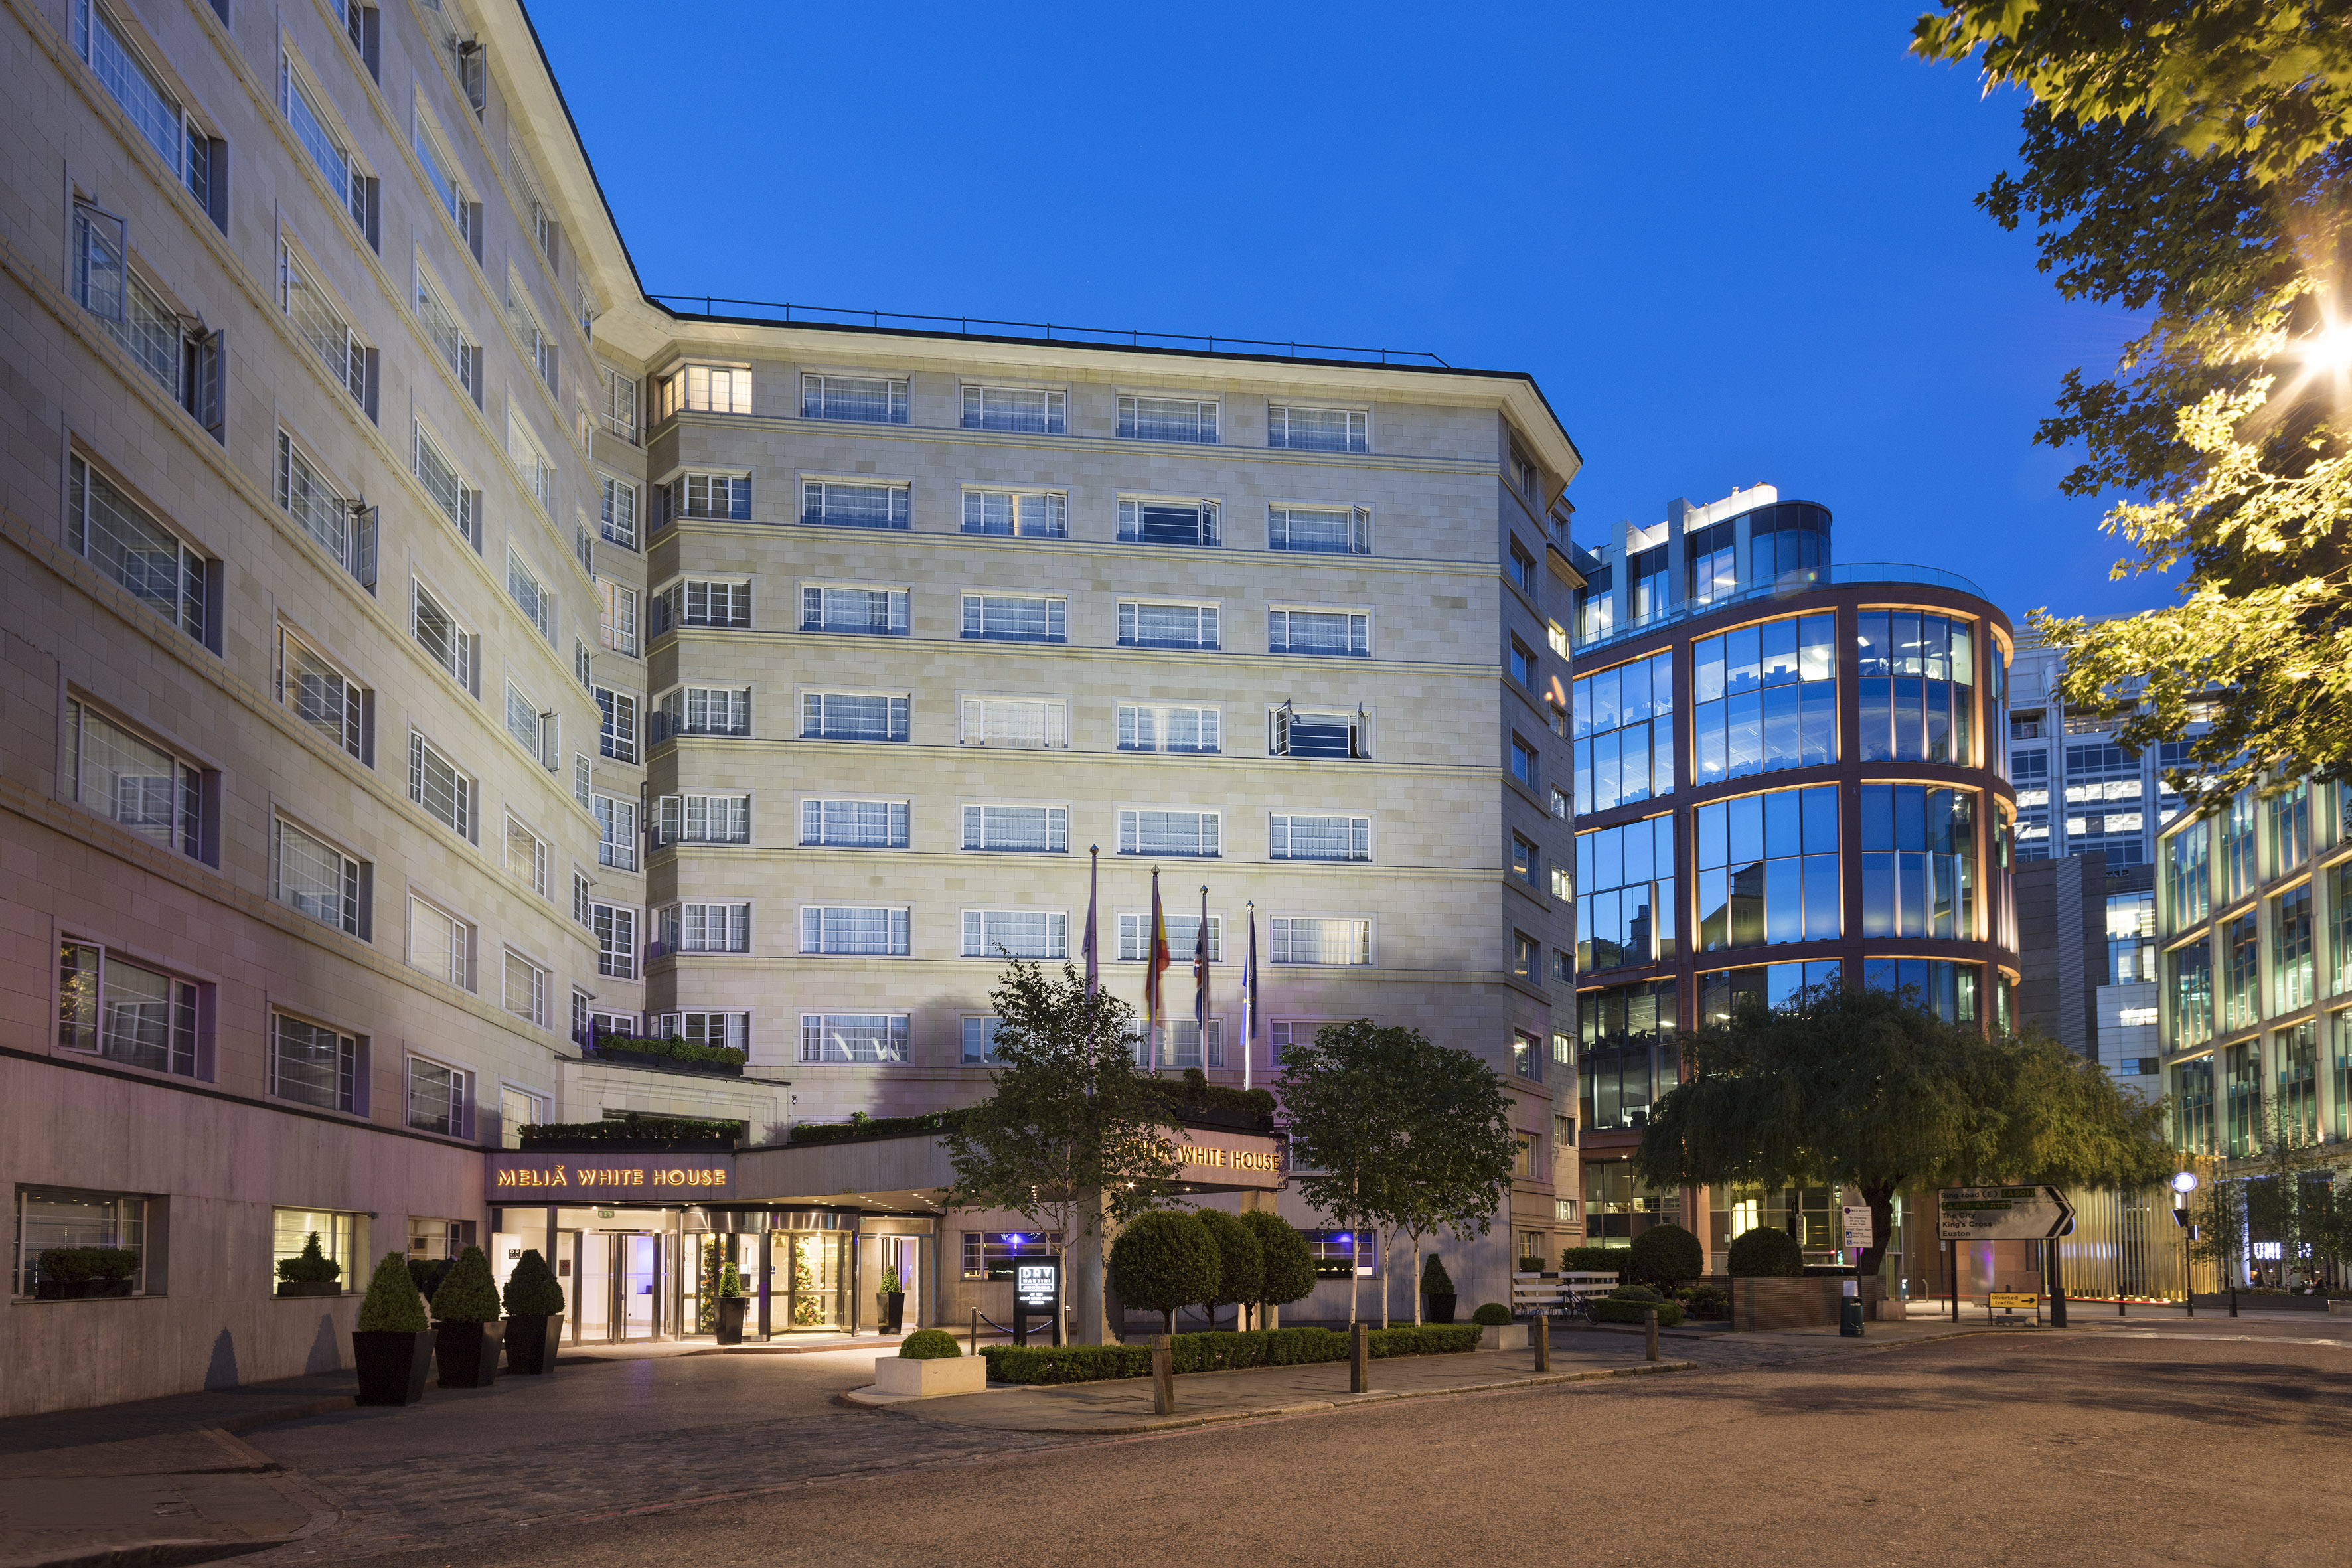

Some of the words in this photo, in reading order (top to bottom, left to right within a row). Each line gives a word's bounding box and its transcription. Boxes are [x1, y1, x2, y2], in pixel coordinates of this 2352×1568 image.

[1178, 1144, 1226, 1168] WHITE
[1231, 1151, 1279, 1172] HOUSE
[577, 1169, 643, 1186] WHITE
[653, 1169, 726, 1186] HOUSE
[1023, 1269, 1051, 1278] DRY
